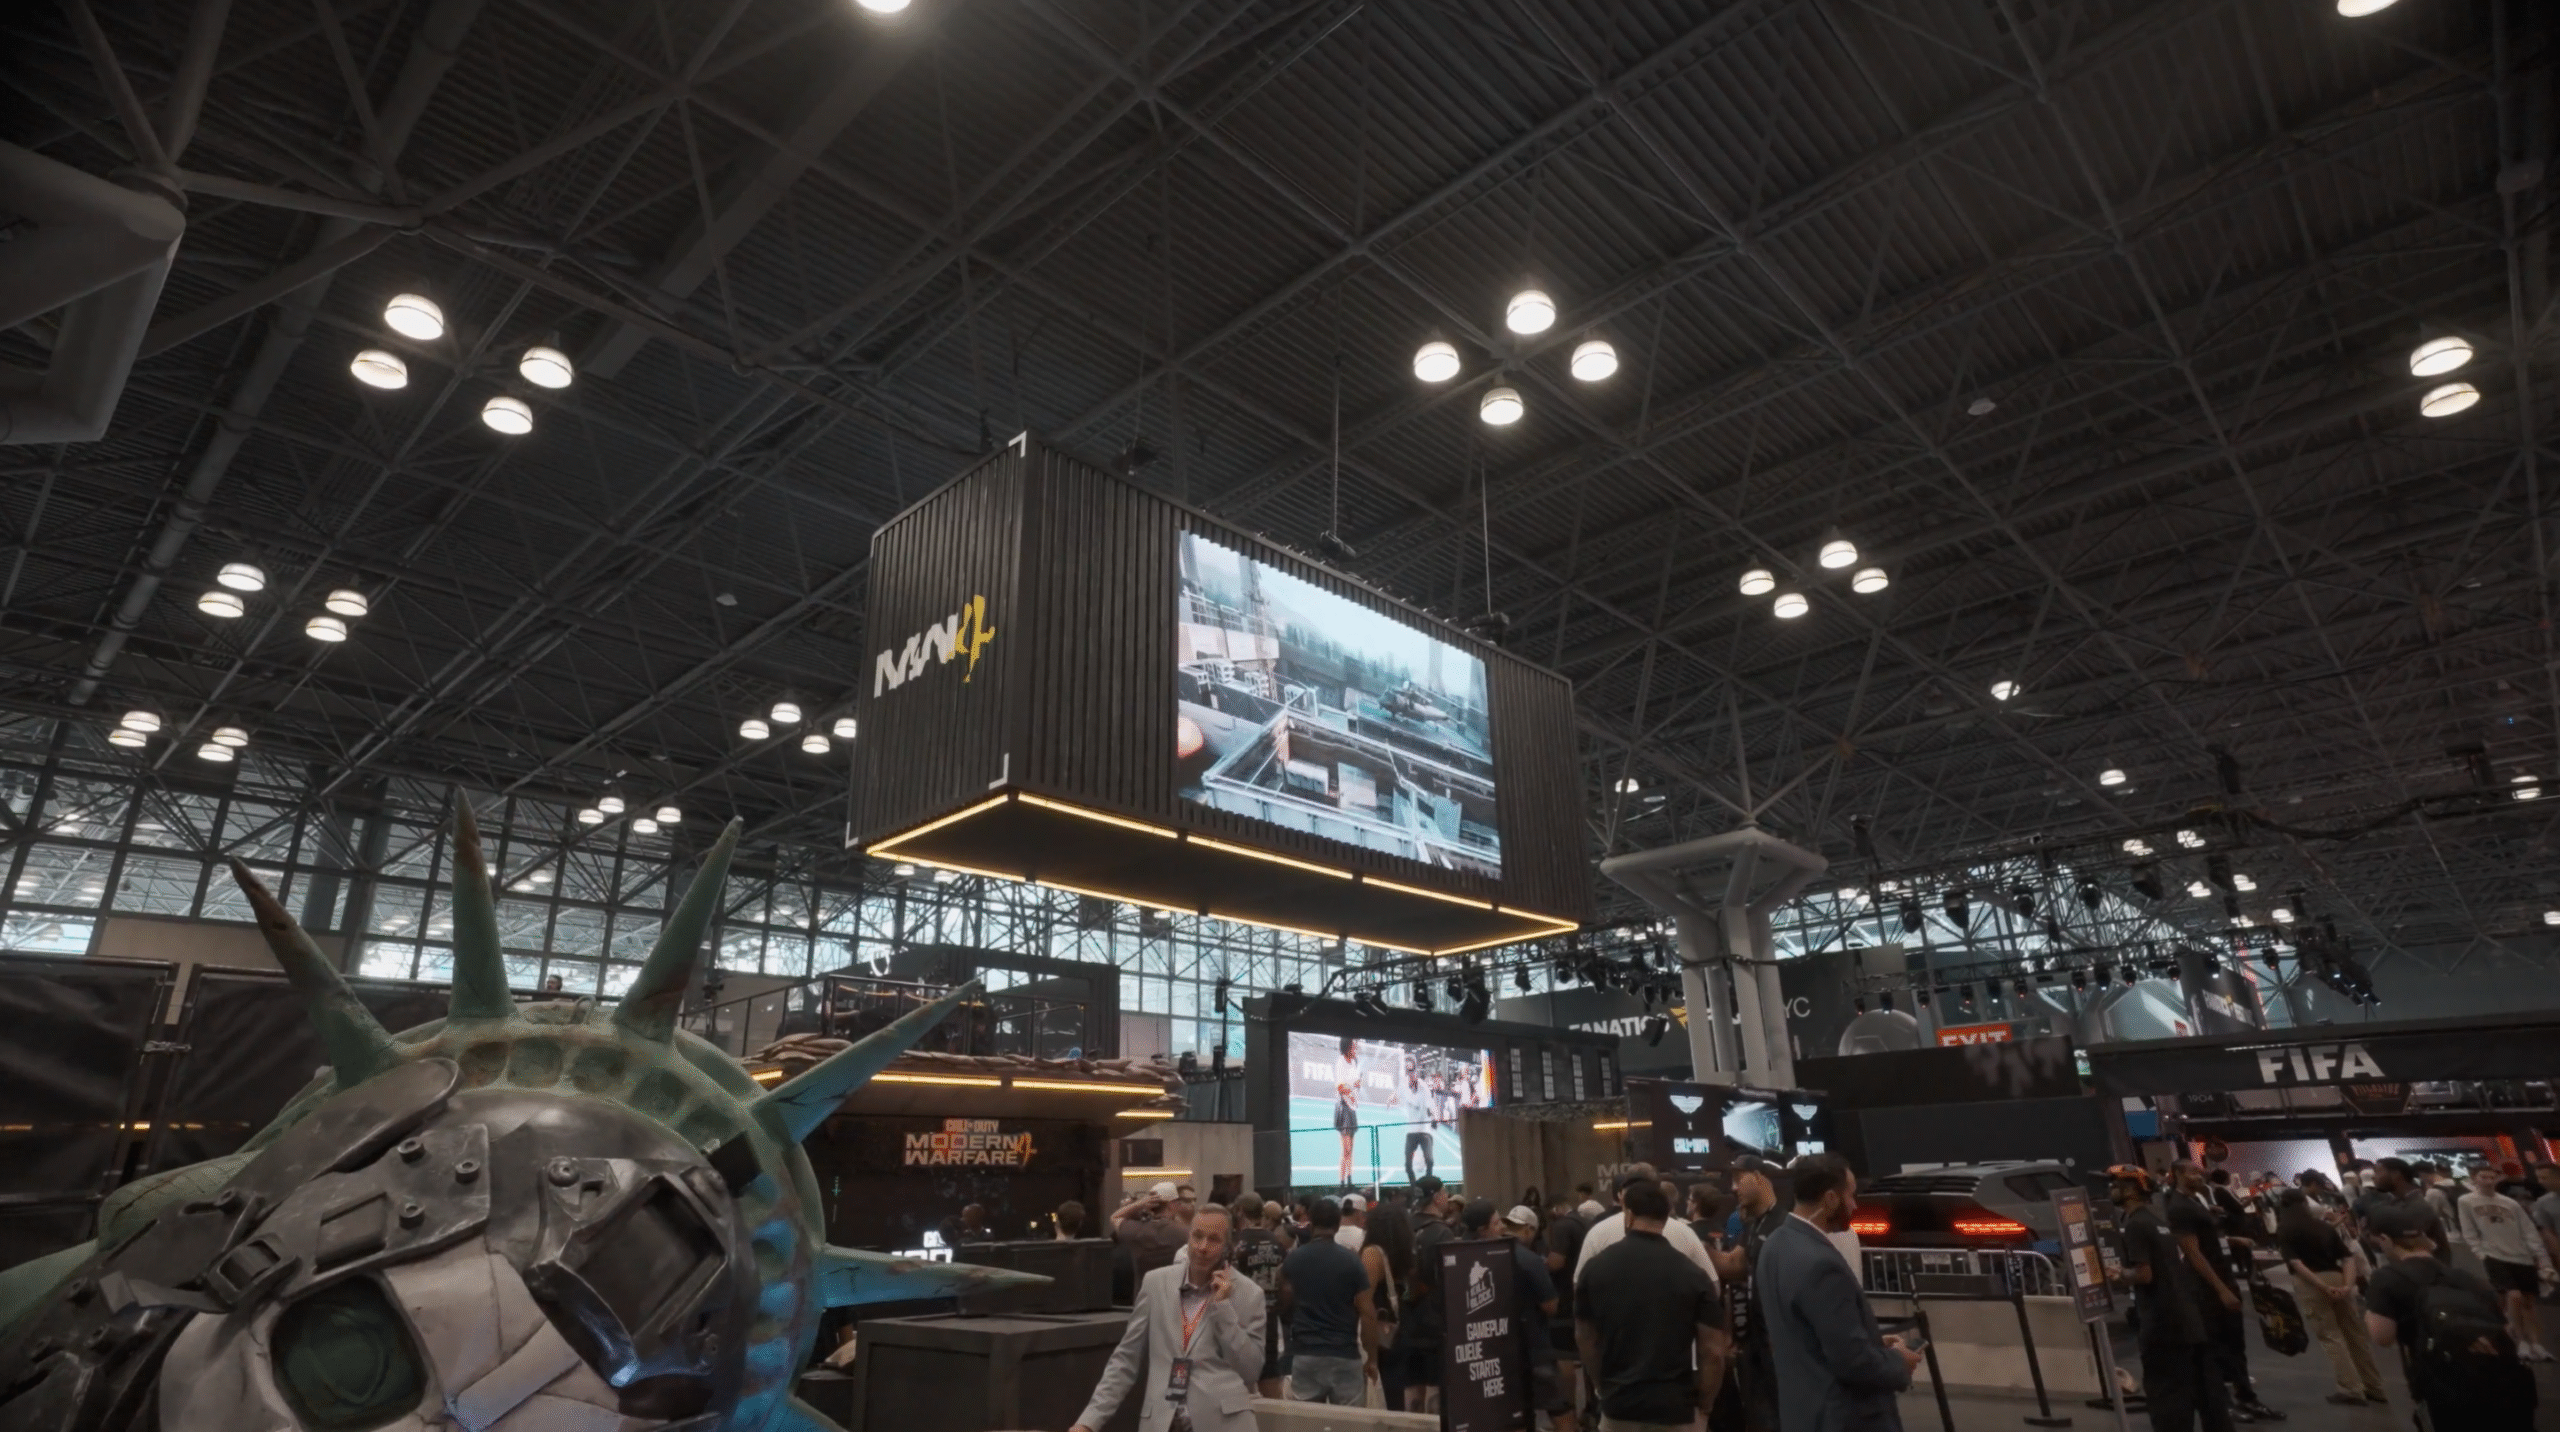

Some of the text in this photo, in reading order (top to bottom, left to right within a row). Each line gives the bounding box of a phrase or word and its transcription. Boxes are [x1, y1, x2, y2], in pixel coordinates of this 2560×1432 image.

[1303, 1062, 1335, 1082] FIFA
[2256, 1044, 2386, 1083] FIFA
[974, 1119, 999, 1133] DUTY
[906, 1133, 1018, 1149] MODERN
[905, 1150, 1018, 1165] WARFARE
[1466, 1317, 1508, 1341] GAMEPLAY
[1455, 1341, 1483, 1364] QUEUE
[1469, 1358, 1501, 1381] STARTS
[1483, 1376, 1505, 1398] HERE
